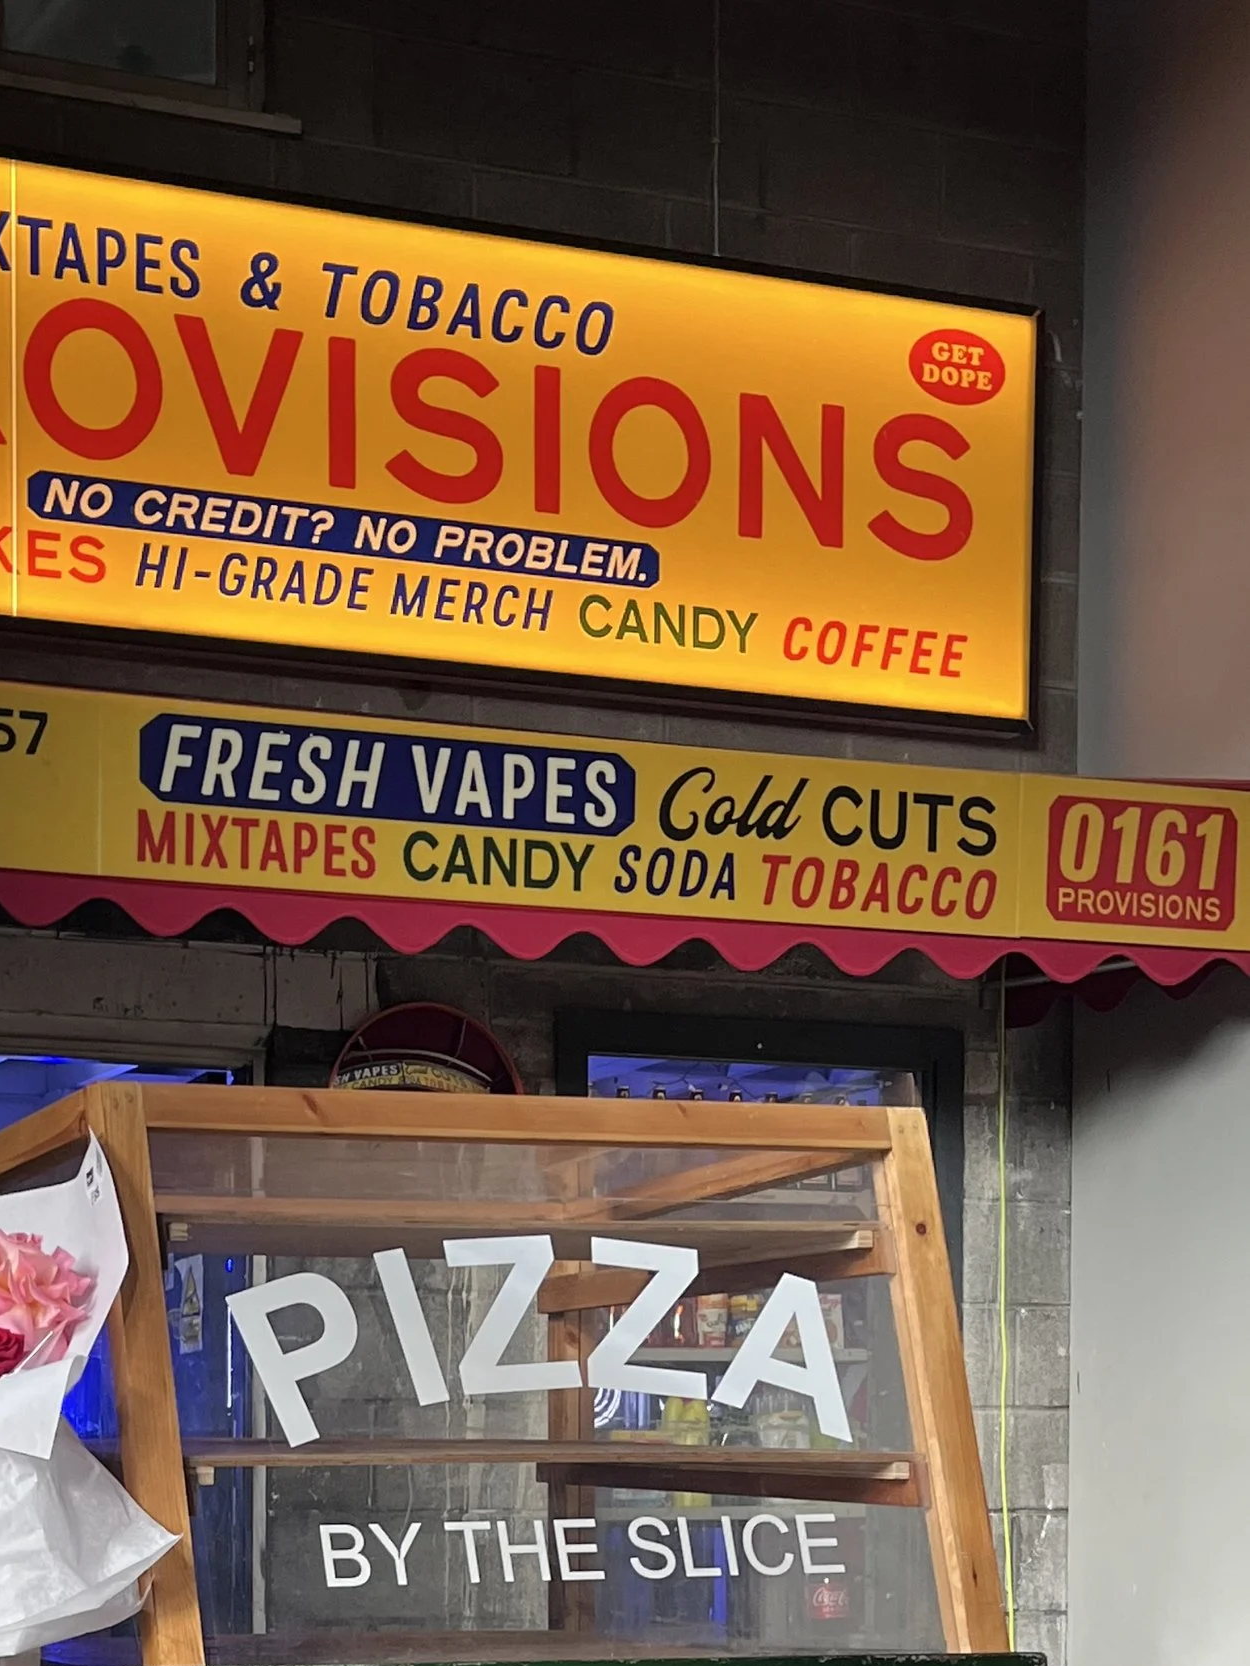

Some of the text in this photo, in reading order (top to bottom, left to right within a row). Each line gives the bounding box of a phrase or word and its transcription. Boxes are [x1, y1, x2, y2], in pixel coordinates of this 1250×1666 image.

[239, 251, 282, 311] &
[322, 262, 614, 356] TOBACCO
[931, 341, 984, 367] GET
[921, 363, 993, 391] DOPE
[43, 478, 114, 518] NO
[132, 489, 336, 544] CREDIT?
[354, 515, 419, 555] NO
[433, 525, 648, 582] PROBLEM.
[135, 543, 375, 611] HI-GRADE
[390, 575, 554, 632] MERCH
[578, 594, 759, 654] CANDY
[782, 616, 969, 678] COFFEE
[159, 723, 997, 857] FRESH VAPES Cold CUTS
[137, 808, 997, 920] MIXTAPES CANDY SODA TOBACCO
[1059, 802, 1225, 891] 0161
[1058, 887, 1221, 924] PROVISIONS
[225, 1235, 853, 1448] PIZZA
[319, 1513, 846, 1588] BY THE SLICE
